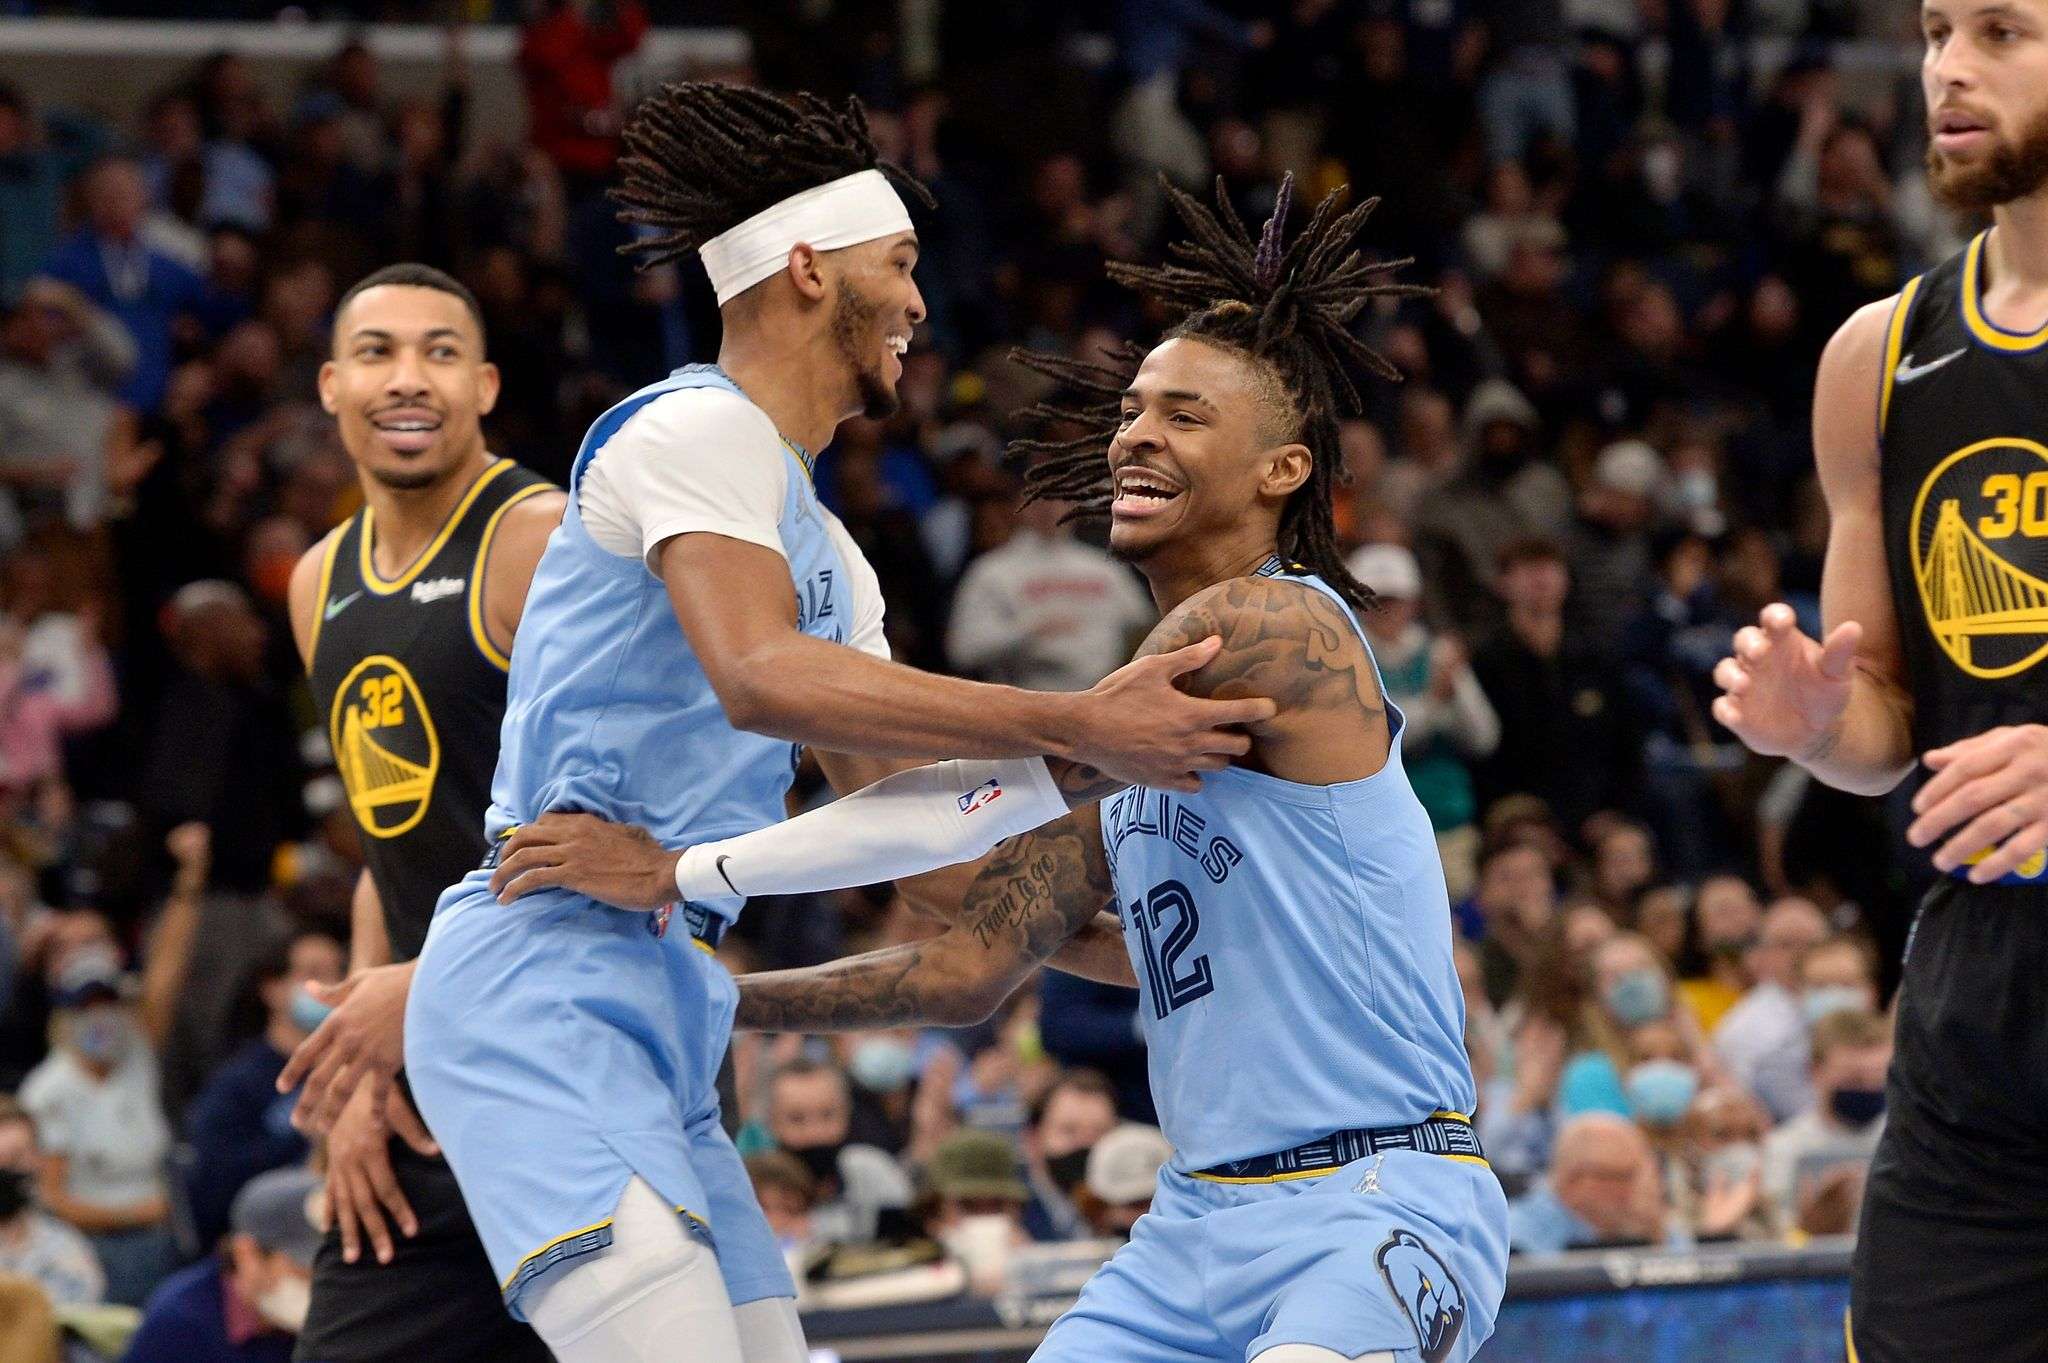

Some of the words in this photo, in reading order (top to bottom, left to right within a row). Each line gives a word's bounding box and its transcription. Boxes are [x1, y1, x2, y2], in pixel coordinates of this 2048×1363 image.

[1977, 471, 2048, 539] 30
[361, 674, 404, 729] 32
[1130, 879, 1214, 1021] 12
